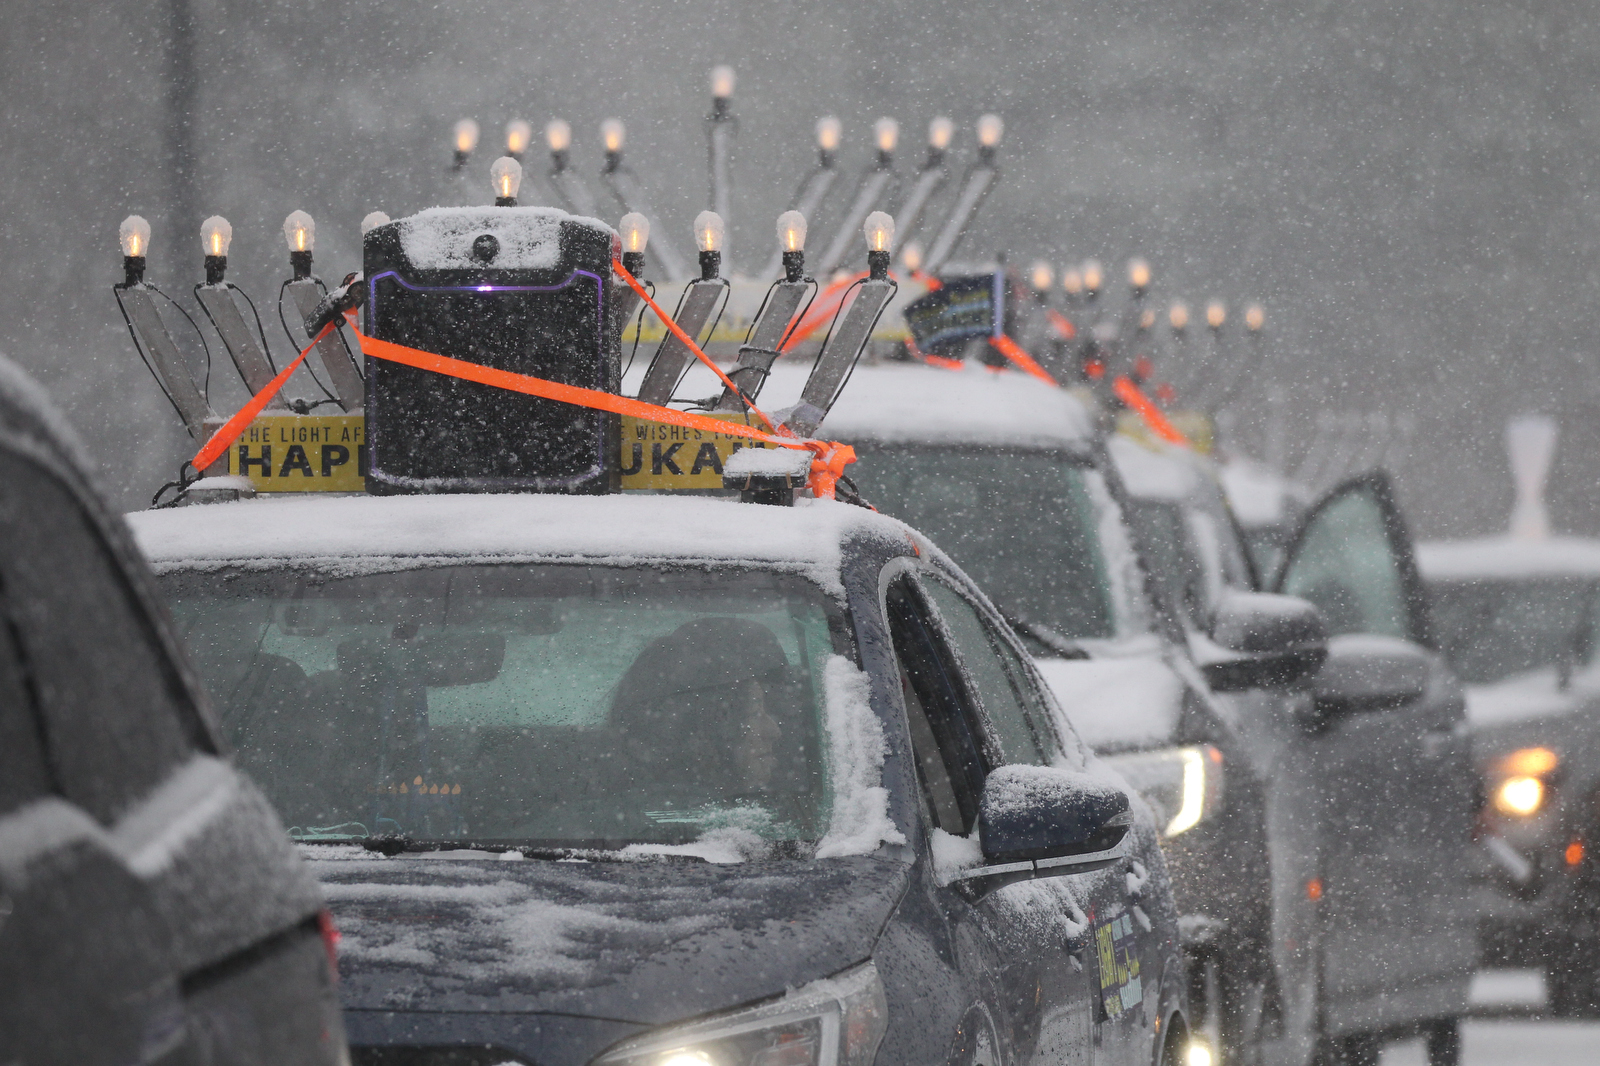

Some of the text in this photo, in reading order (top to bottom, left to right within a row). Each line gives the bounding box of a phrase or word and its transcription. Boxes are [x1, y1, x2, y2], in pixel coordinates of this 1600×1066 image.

[281, 427, 330, 442] LIGHT
[341, 427, 364, 442] AF
[636, 424, 703, 440] WISHES
